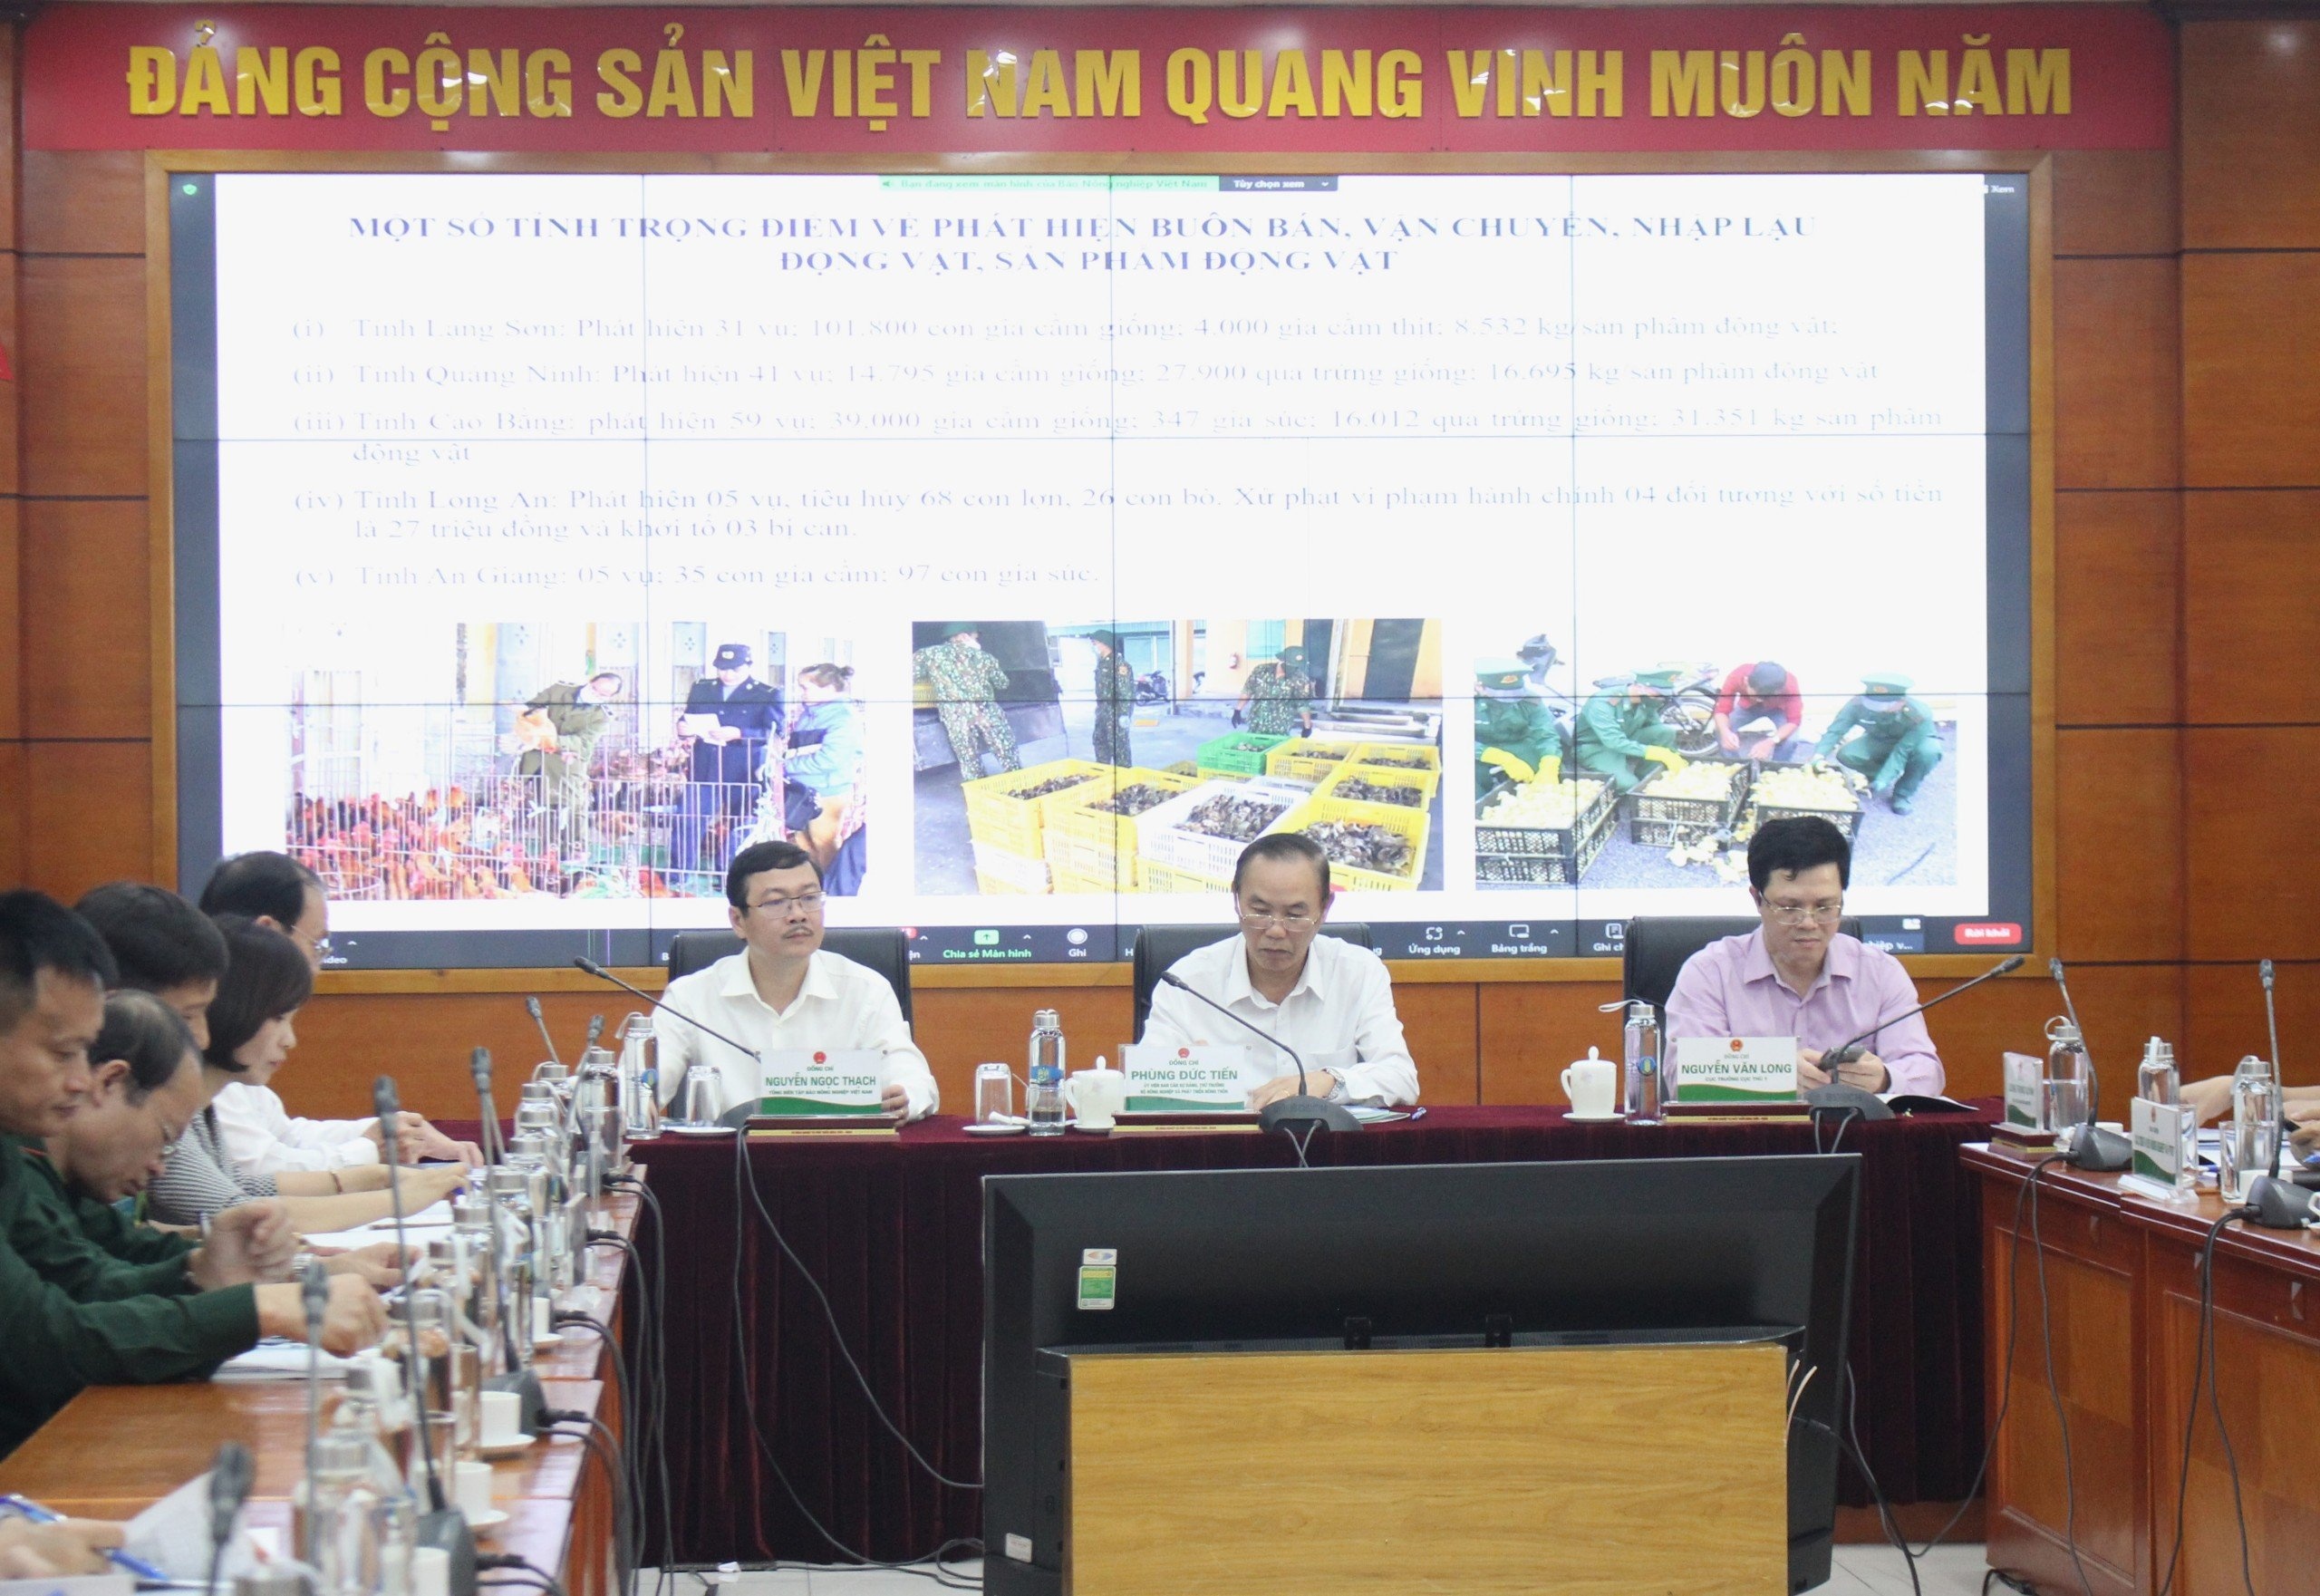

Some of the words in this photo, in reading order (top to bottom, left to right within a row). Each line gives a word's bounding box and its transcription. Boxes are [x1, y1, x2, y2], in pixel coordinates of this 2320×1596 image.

[126, 20, 341, 116] ĐẢNG
[364, 33, 572, 131] CỘNG
[597, 24, 753, 118] SẢN
[782, 34, 941, 131] VIỆT
[966, 50, 1141, 117] NAM
[1166, 47, 1422, 124] QUANG
[1447, 50, 1623, 117] VINH
[1650, 34, 1870, 118] MUÔN
[1899, 34, 2071, 116] NĂM
[1151, 210, 1253, 238] BUÔN
[577, 318, 634, 337] Phát
[927, 324, 974, 337] con
[985, 318, 1024, 341] gia
[1278, 317, 1318, 341] gia
[1538, 316, 1571, 340] kg
[613, 364, 671, 383] Phát
[945, 363, 985, 388] gia
[1589, 362, 1619, 386] kg
[589, 411, 647, 436] phát
[933, 411, 972, 435] gia
[1213, 410, 1252, 433] gia
[1774, 407, 1804, 431] kg
[570, 489, 627, 508] Phát
[962, 494, 1010, 508] con
[1125, 493, 1172, 507] con
[716, 570, 764, 584] con
[774, 564, 814, 589] gia
[940, 569, 988, 583] con
[998, 563, 1038, 587] gia
[942, 949, 966, 958] Chia
[1068, 949, 1087, 957] Ghi
[1593, 943, 1610, 952] Ghi
[1131, 1068, 1175, 1079] PHÙNG
[1179, 1068, 1205, 1079] ĐỨC
[1210, 1066, 1238, 1079] TIẾN
[1681, 1059, 1729, 1074] NGUYỄN
[1733, 1061, 1758, 1074] VĂN
[1761, 1063, 1792, 1074] LONG
[766, 1071, 807, 1086] NGUYỄN
[810, 1076, 839, 1088] NGỌC
[842, 1076, 876, 1088] THẠCH
